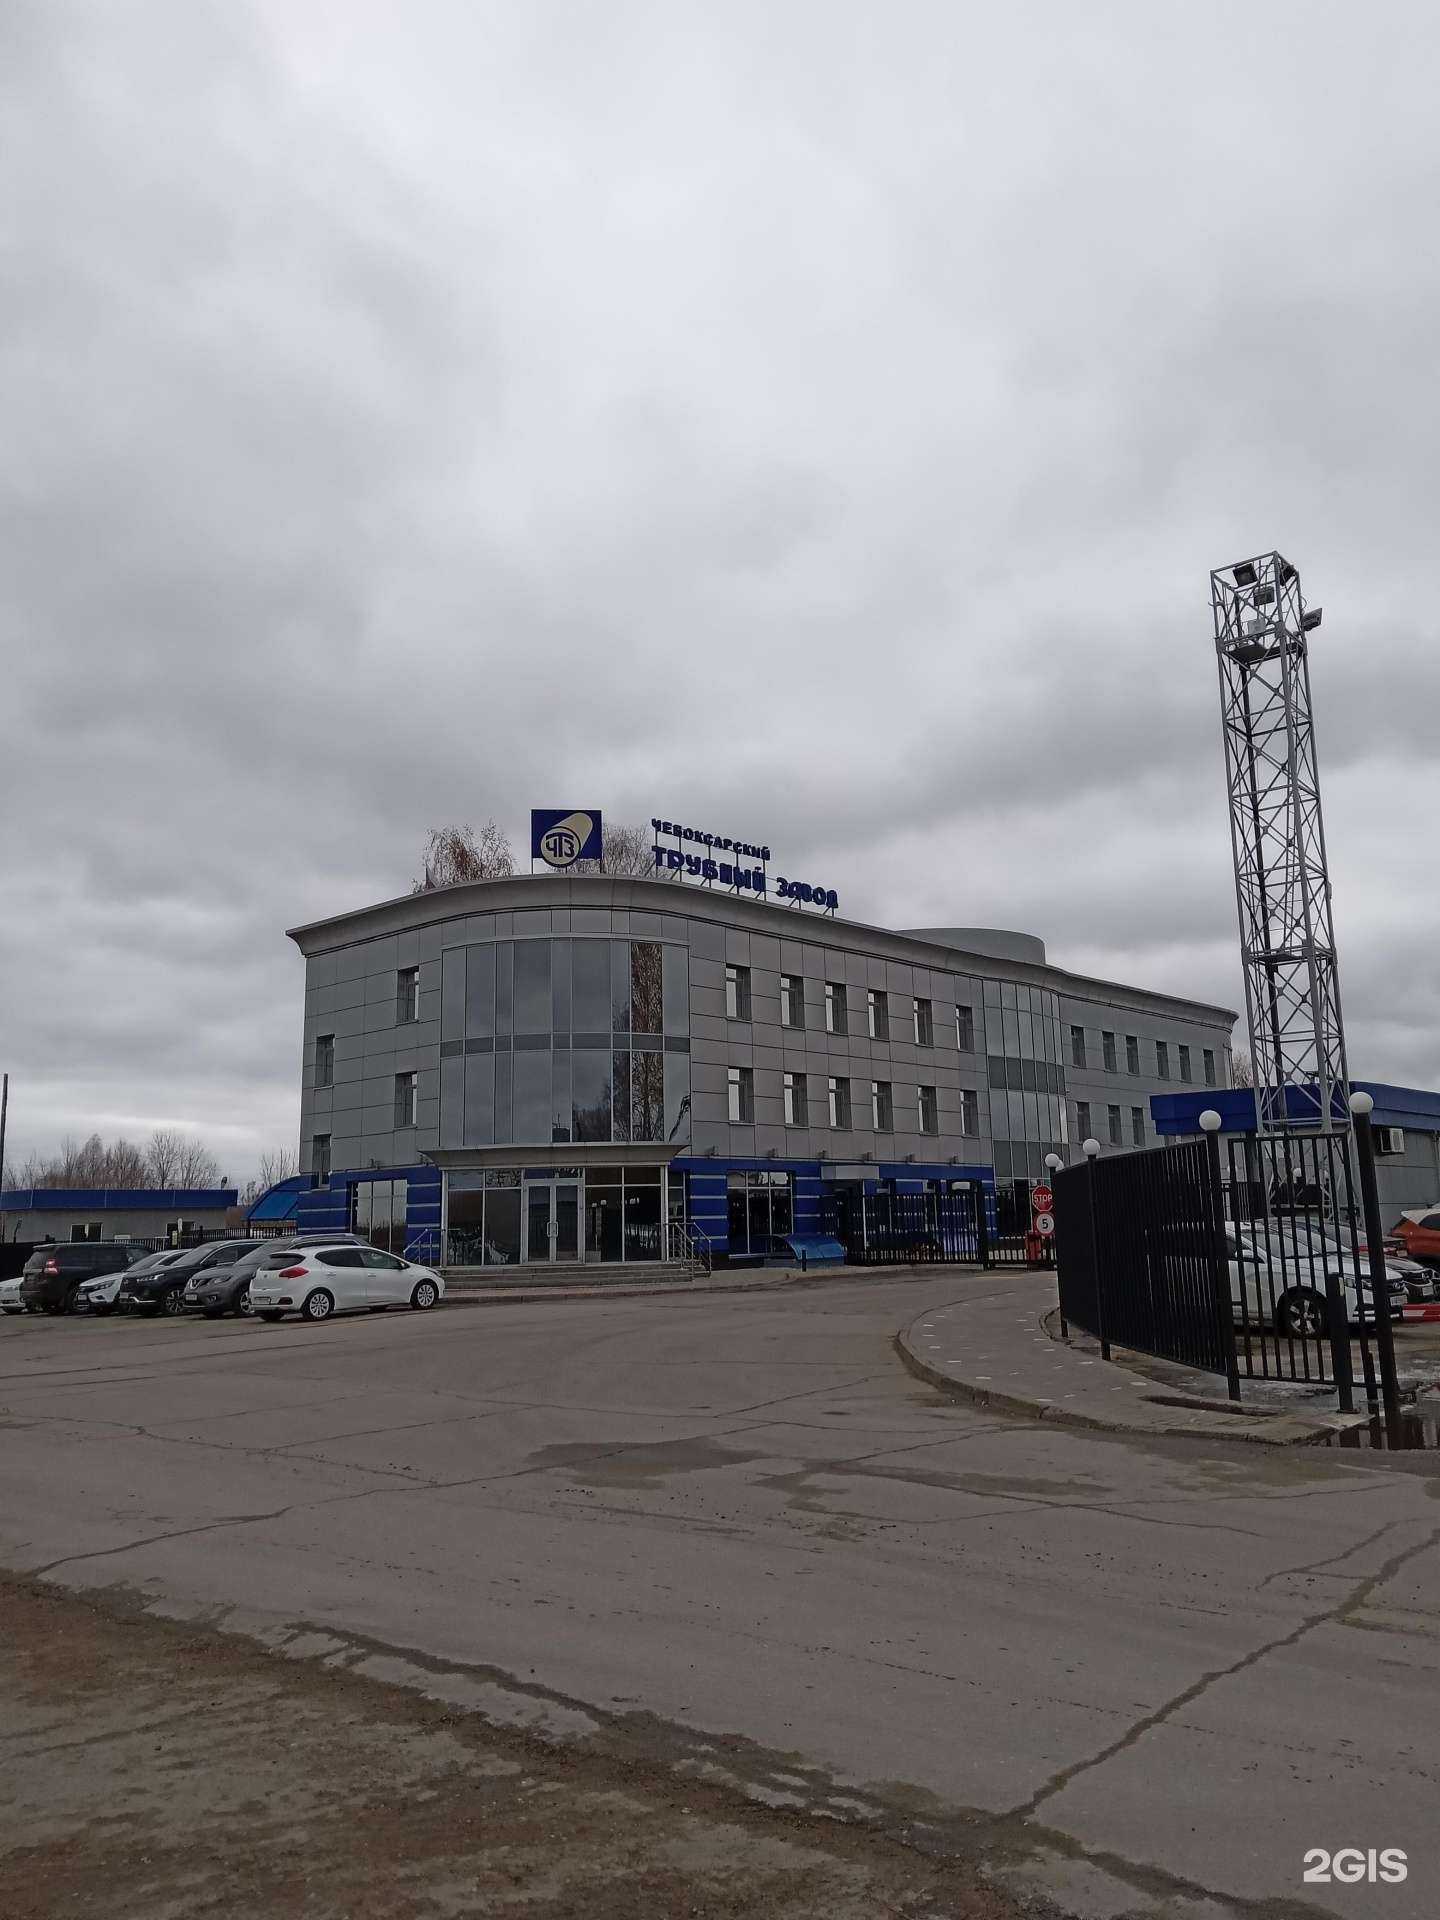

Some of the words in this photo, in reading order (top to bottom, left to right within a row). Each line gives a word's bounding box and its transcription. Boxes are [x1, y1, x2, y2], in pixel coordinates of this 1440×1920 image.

[545, 832, 575, 857] ЧТЗ
[651, 818, 771, 861] ЧЕБОКСАРСКИЙ
[652, 845, 766, 892] ТРУБНЫЙ
[776, 877, 839, 908] ЗАВОД
[1033, 1194, 1053, 1202] STOP
[1042, 1218, 1049, 1229] 5
